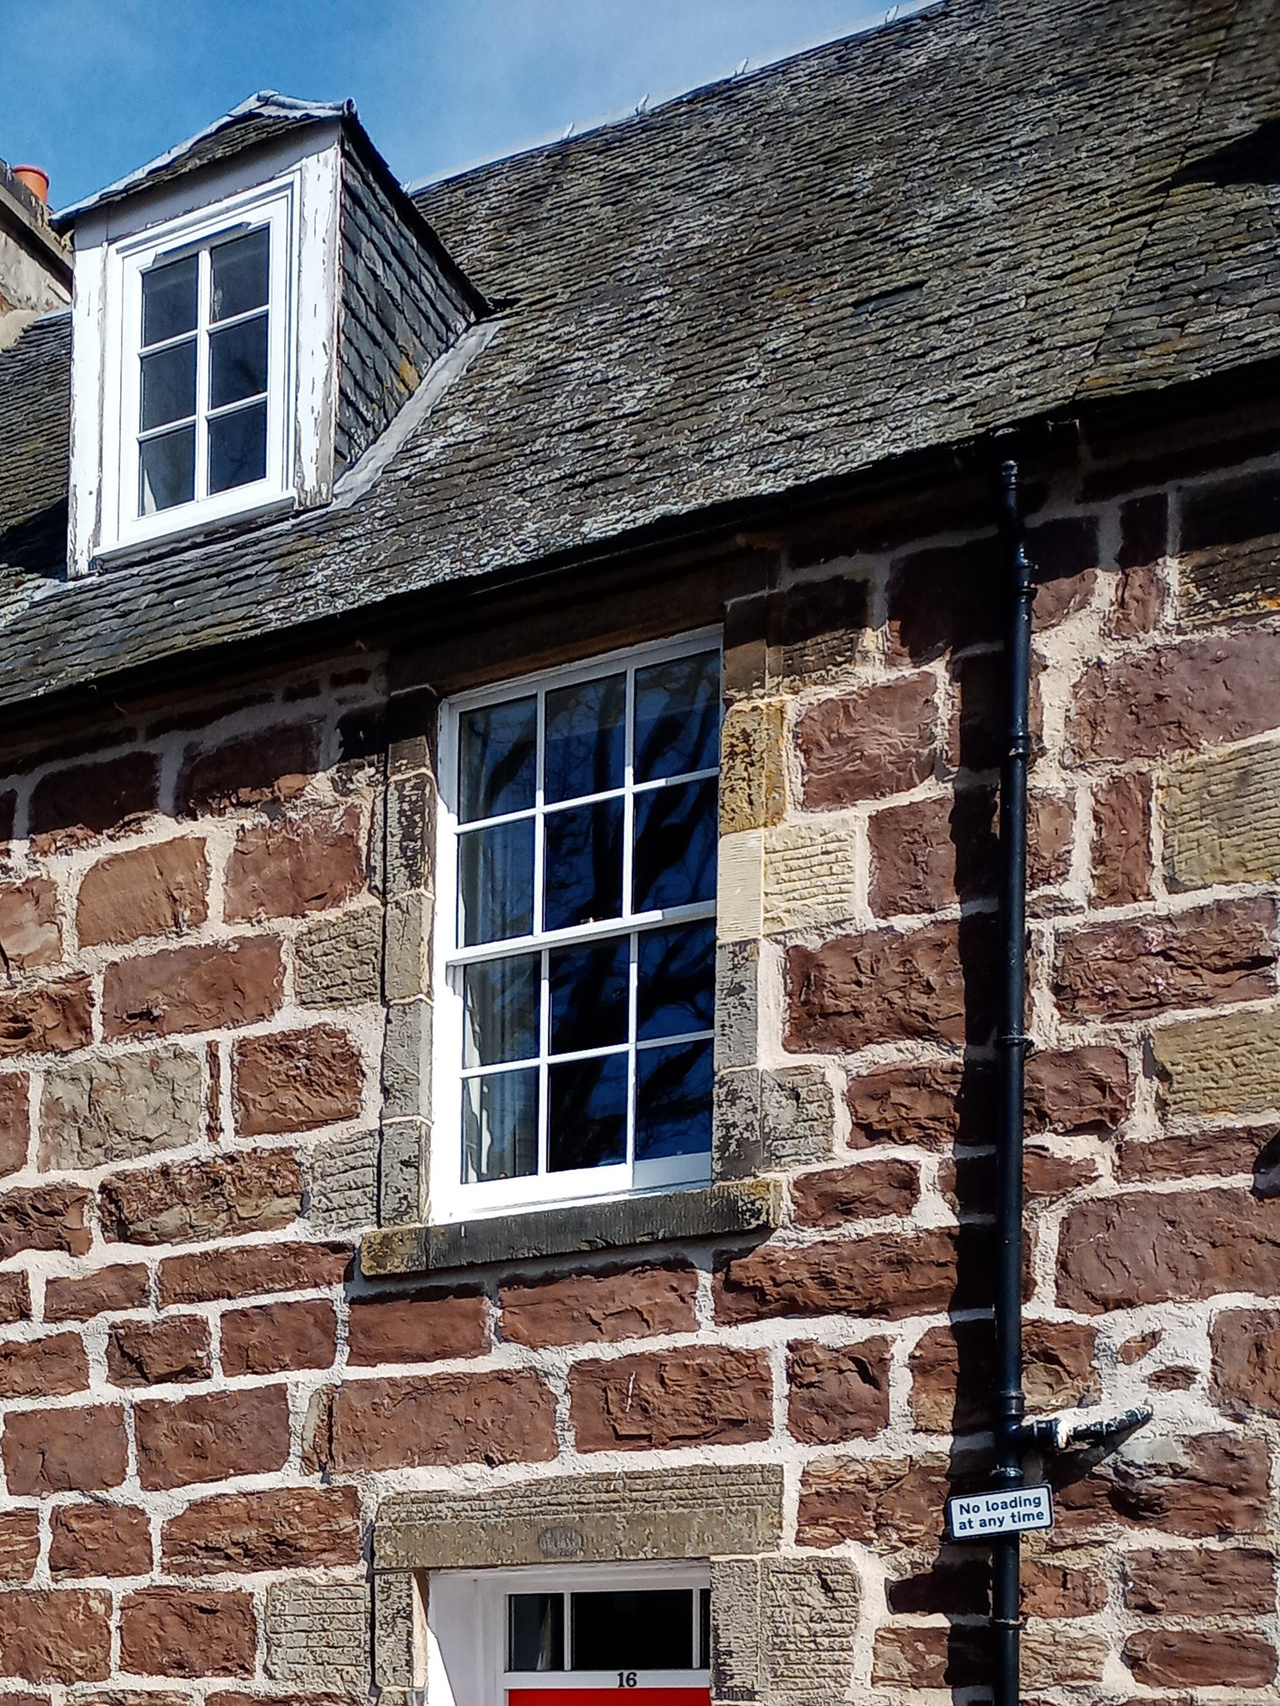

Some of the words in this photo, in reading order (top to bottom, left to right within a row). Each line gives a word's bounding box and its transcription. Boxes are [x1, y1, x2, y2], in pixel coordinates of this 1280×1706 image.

[959, 1503, 980, 1515] No
[986, 1496, 1042, 1512] loading
[959, 1518, 974, 1530] at
[979, 1516, 1005, 1528] any
[1010, 1511, 1044, 1523] time
[617, 1672, 637, 1688] 16
